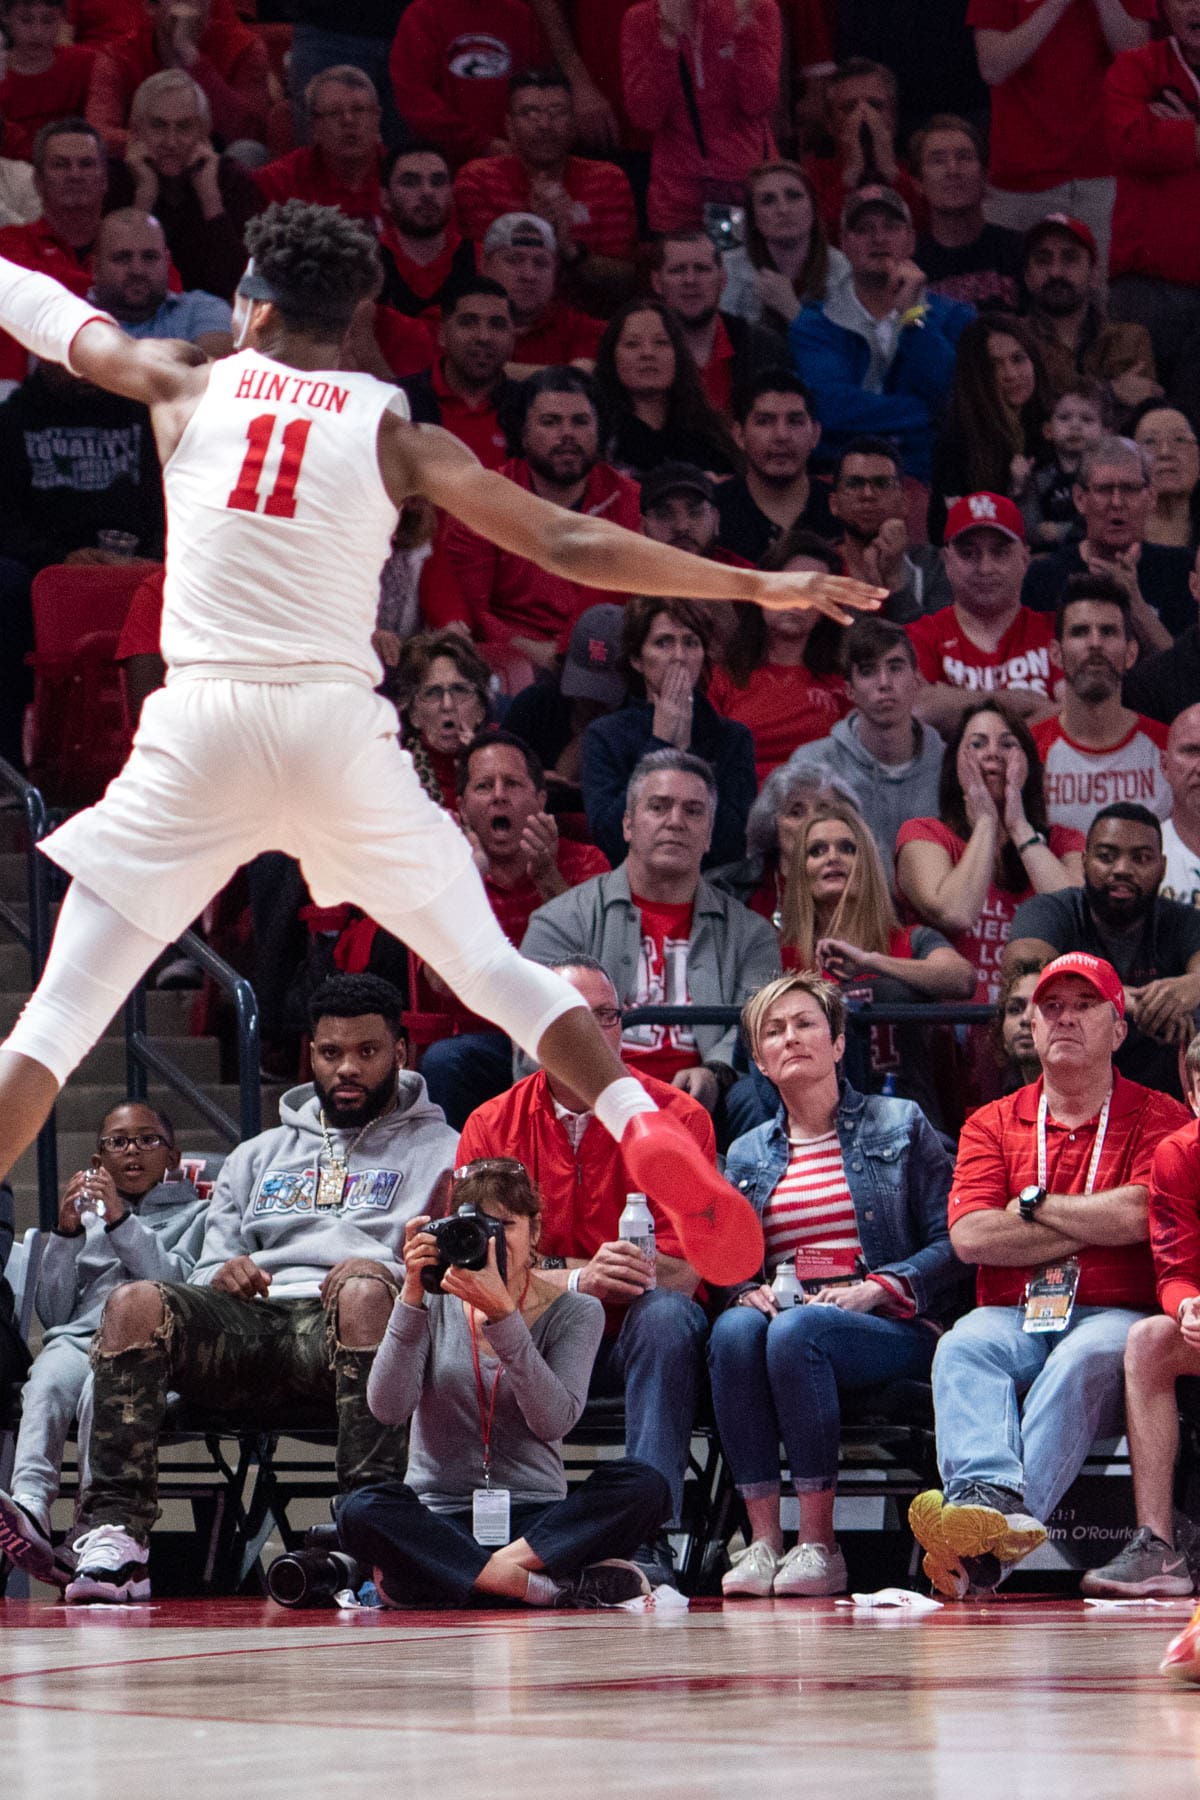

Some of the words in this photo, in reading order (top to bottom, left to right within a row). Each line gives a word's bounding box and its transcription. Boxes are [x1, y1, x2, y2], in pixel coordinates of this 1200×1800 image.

[235, 369, 350, 414] HINTON
[226, 413, 313, 519] 11
[1045, 768, 1156, 805] HOUSTON
[254, 1168, 403, 1216] HOUTON
[1071, 1525, 1137, 1540] O'Rourk
